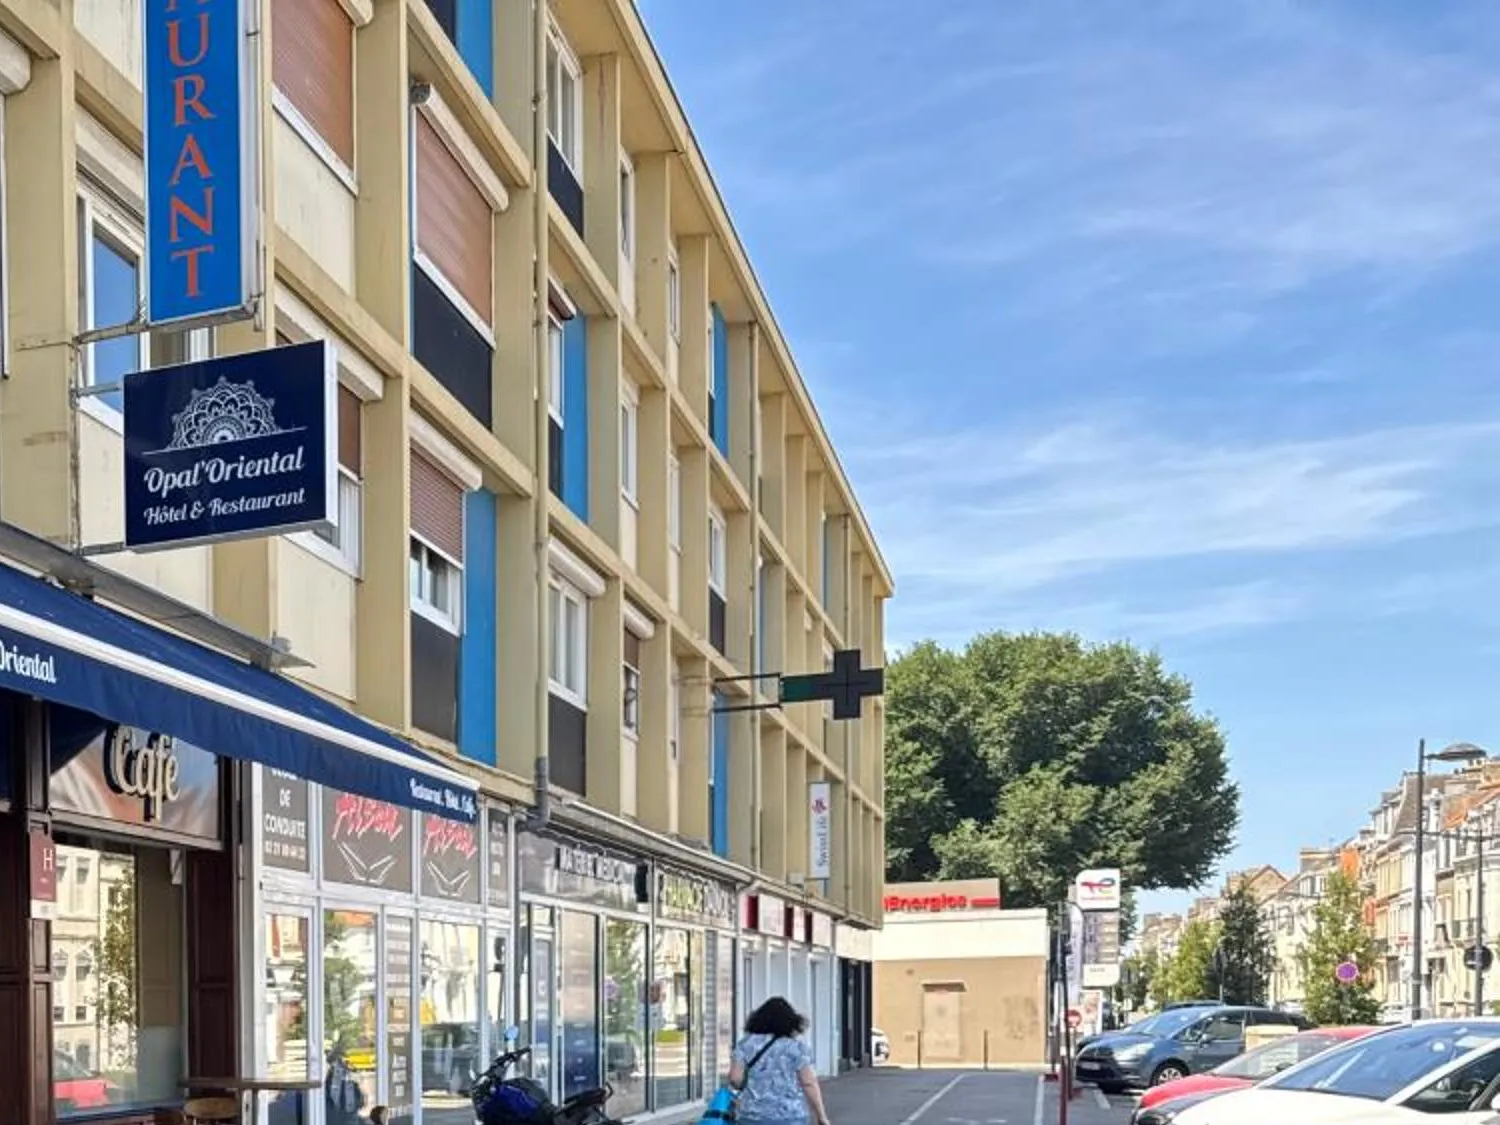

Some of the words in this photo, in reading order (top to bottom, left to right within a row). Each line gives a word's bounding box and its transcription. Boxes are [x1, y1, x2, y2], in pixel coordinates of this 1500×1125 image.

[165, 0, 217, 298] URANT
[143, 446, 305, 499] Opal'Oriental
[143, 503, 187, 526] Hôtel
[190, 500, 205, 520] &
[208, 488, 306, 517] Restaurant
[43, 847, 53, 871] H
